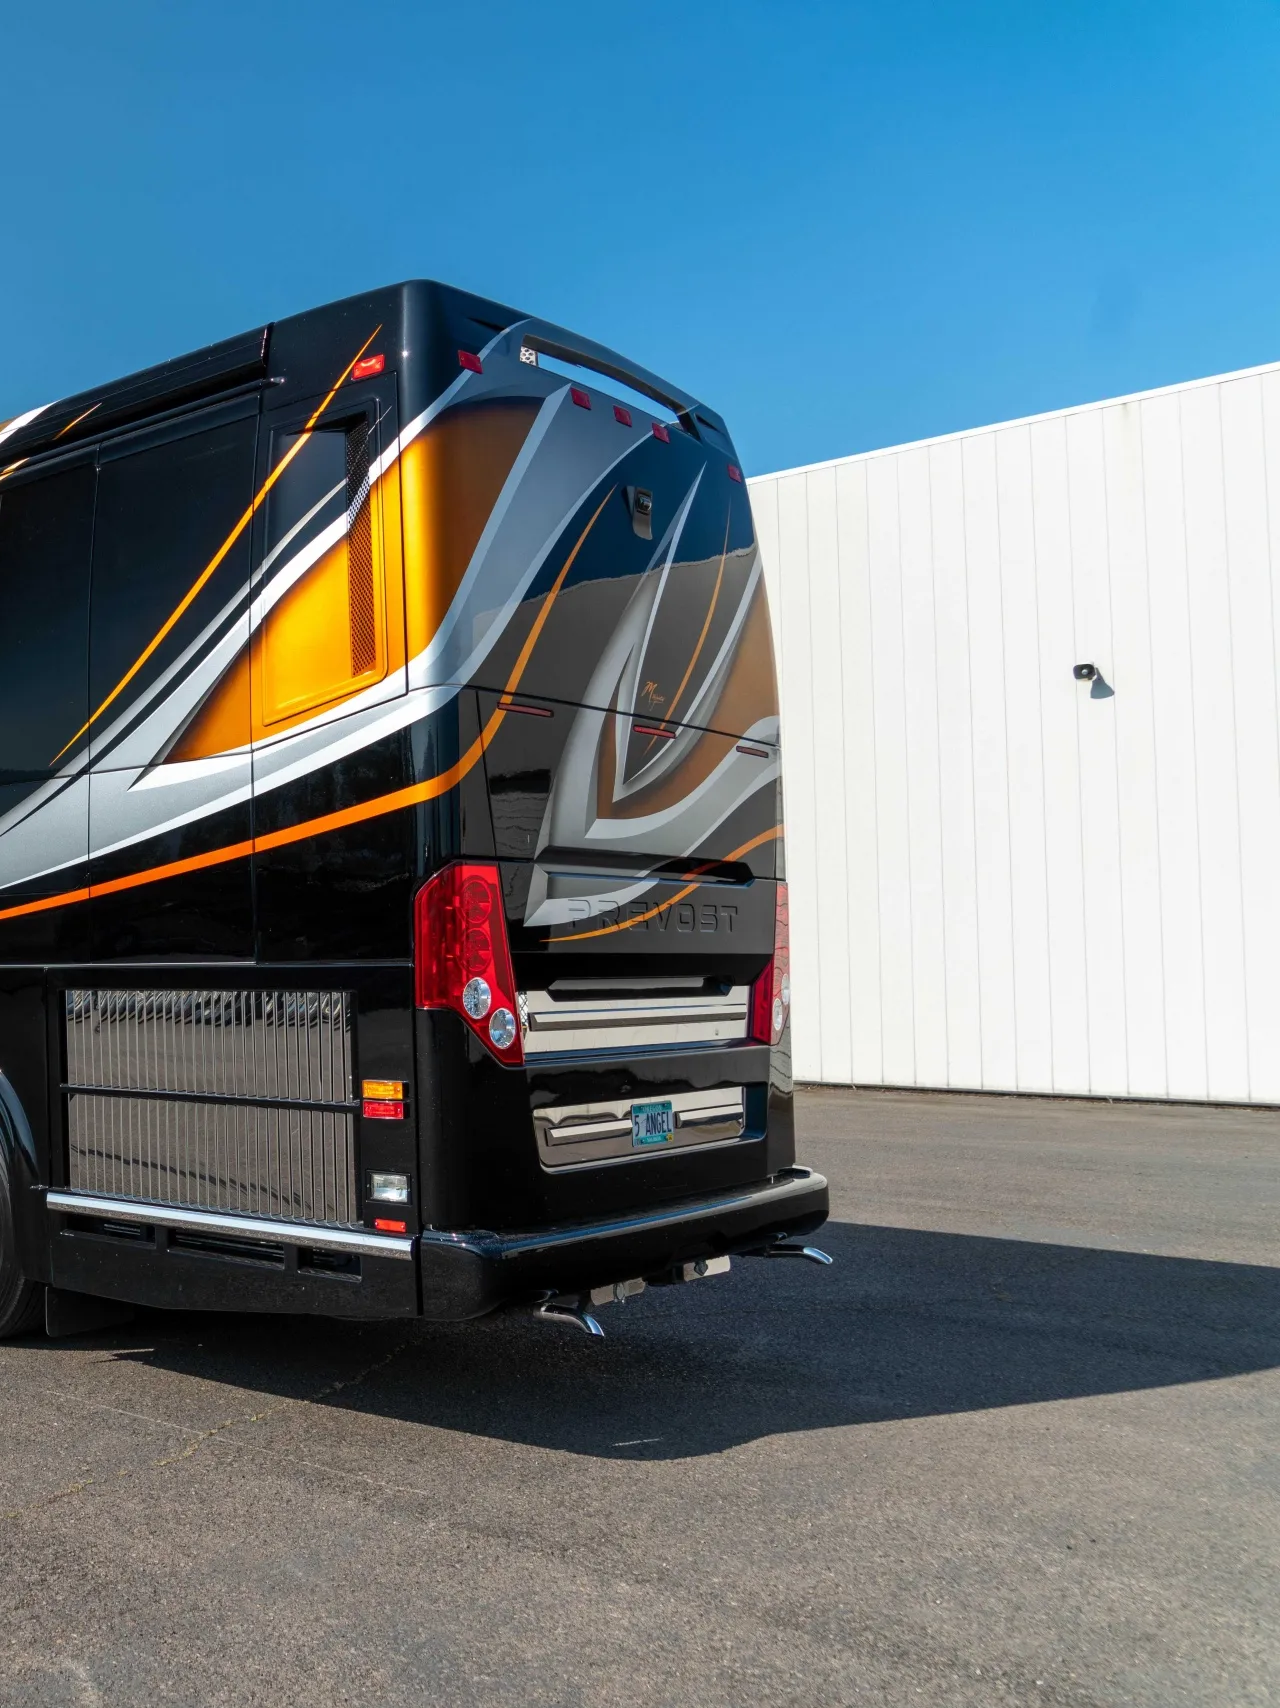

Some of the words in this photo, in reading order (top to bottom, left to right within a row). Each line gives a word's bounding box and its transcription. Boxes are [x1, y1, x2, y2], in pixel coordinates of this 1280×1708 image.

[567, 899, 738, 933] PREVOST
[634, 1114, 640, 1137] 5
[646, 1111, 672, 1136] ANGEL
